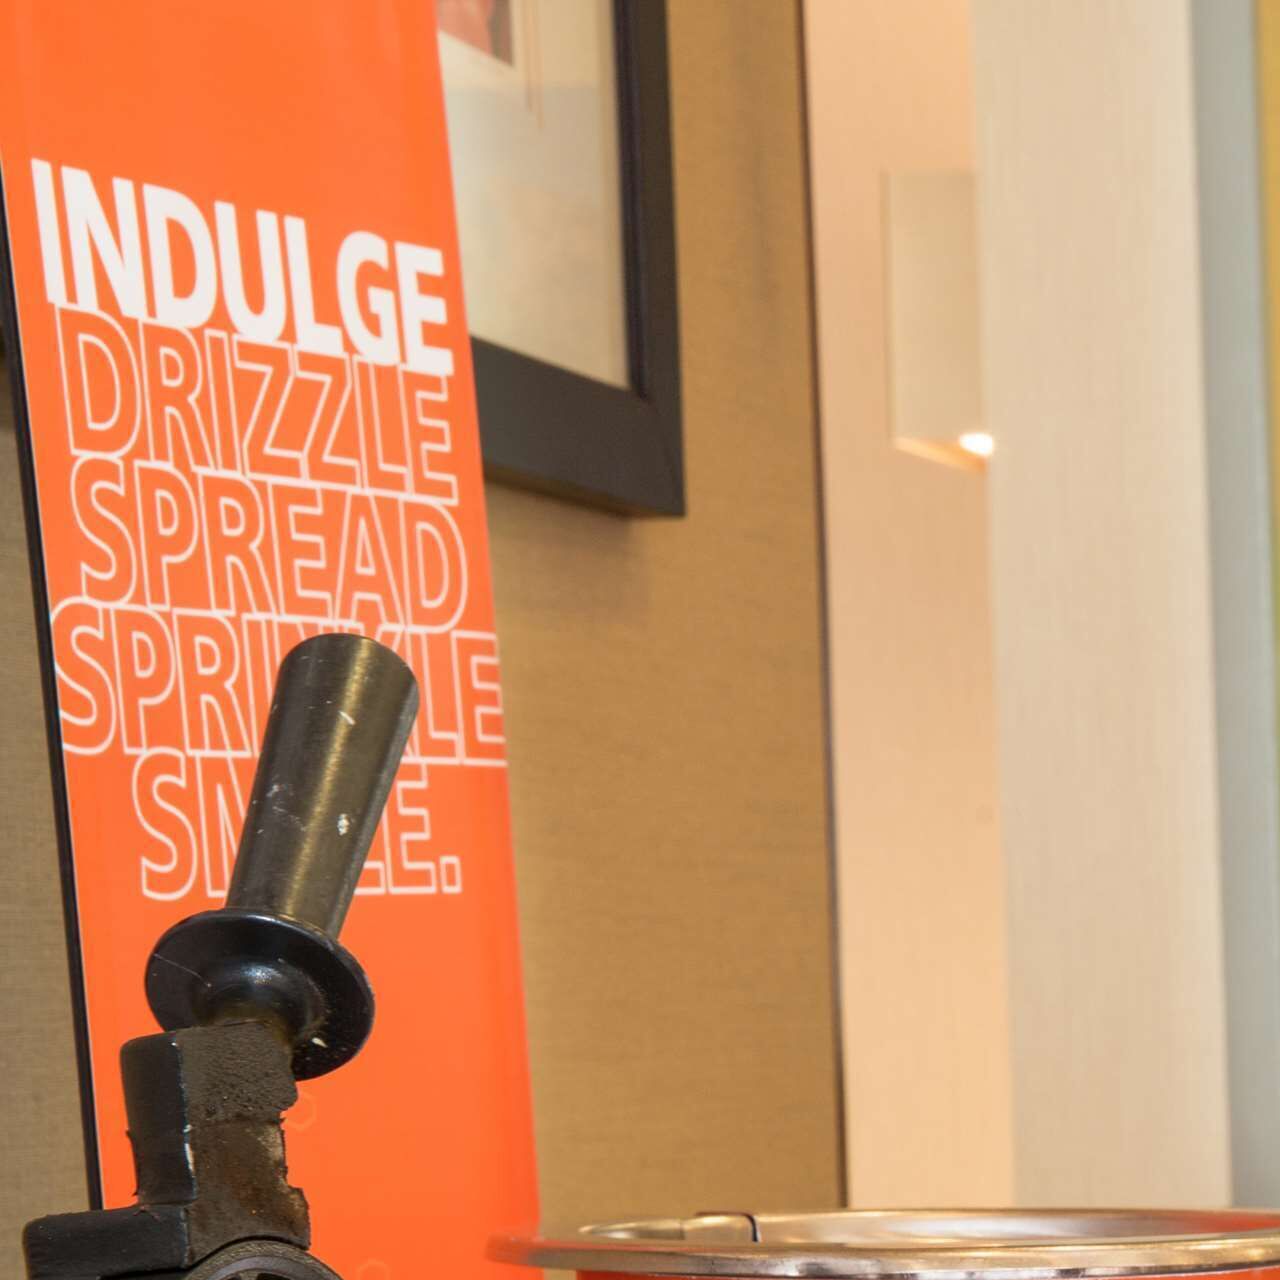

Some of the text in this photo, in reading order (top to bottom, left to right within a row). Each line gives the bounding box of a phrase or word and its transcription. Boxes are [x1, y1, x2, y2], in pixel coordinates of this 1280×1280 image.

[31, 158, 455, 375] INDULGE
[56, 303, 460, 505] DRIZZLE
[70, 452, 468, 634] SPREAD
[50, 596, 509, 767] SPRILE
